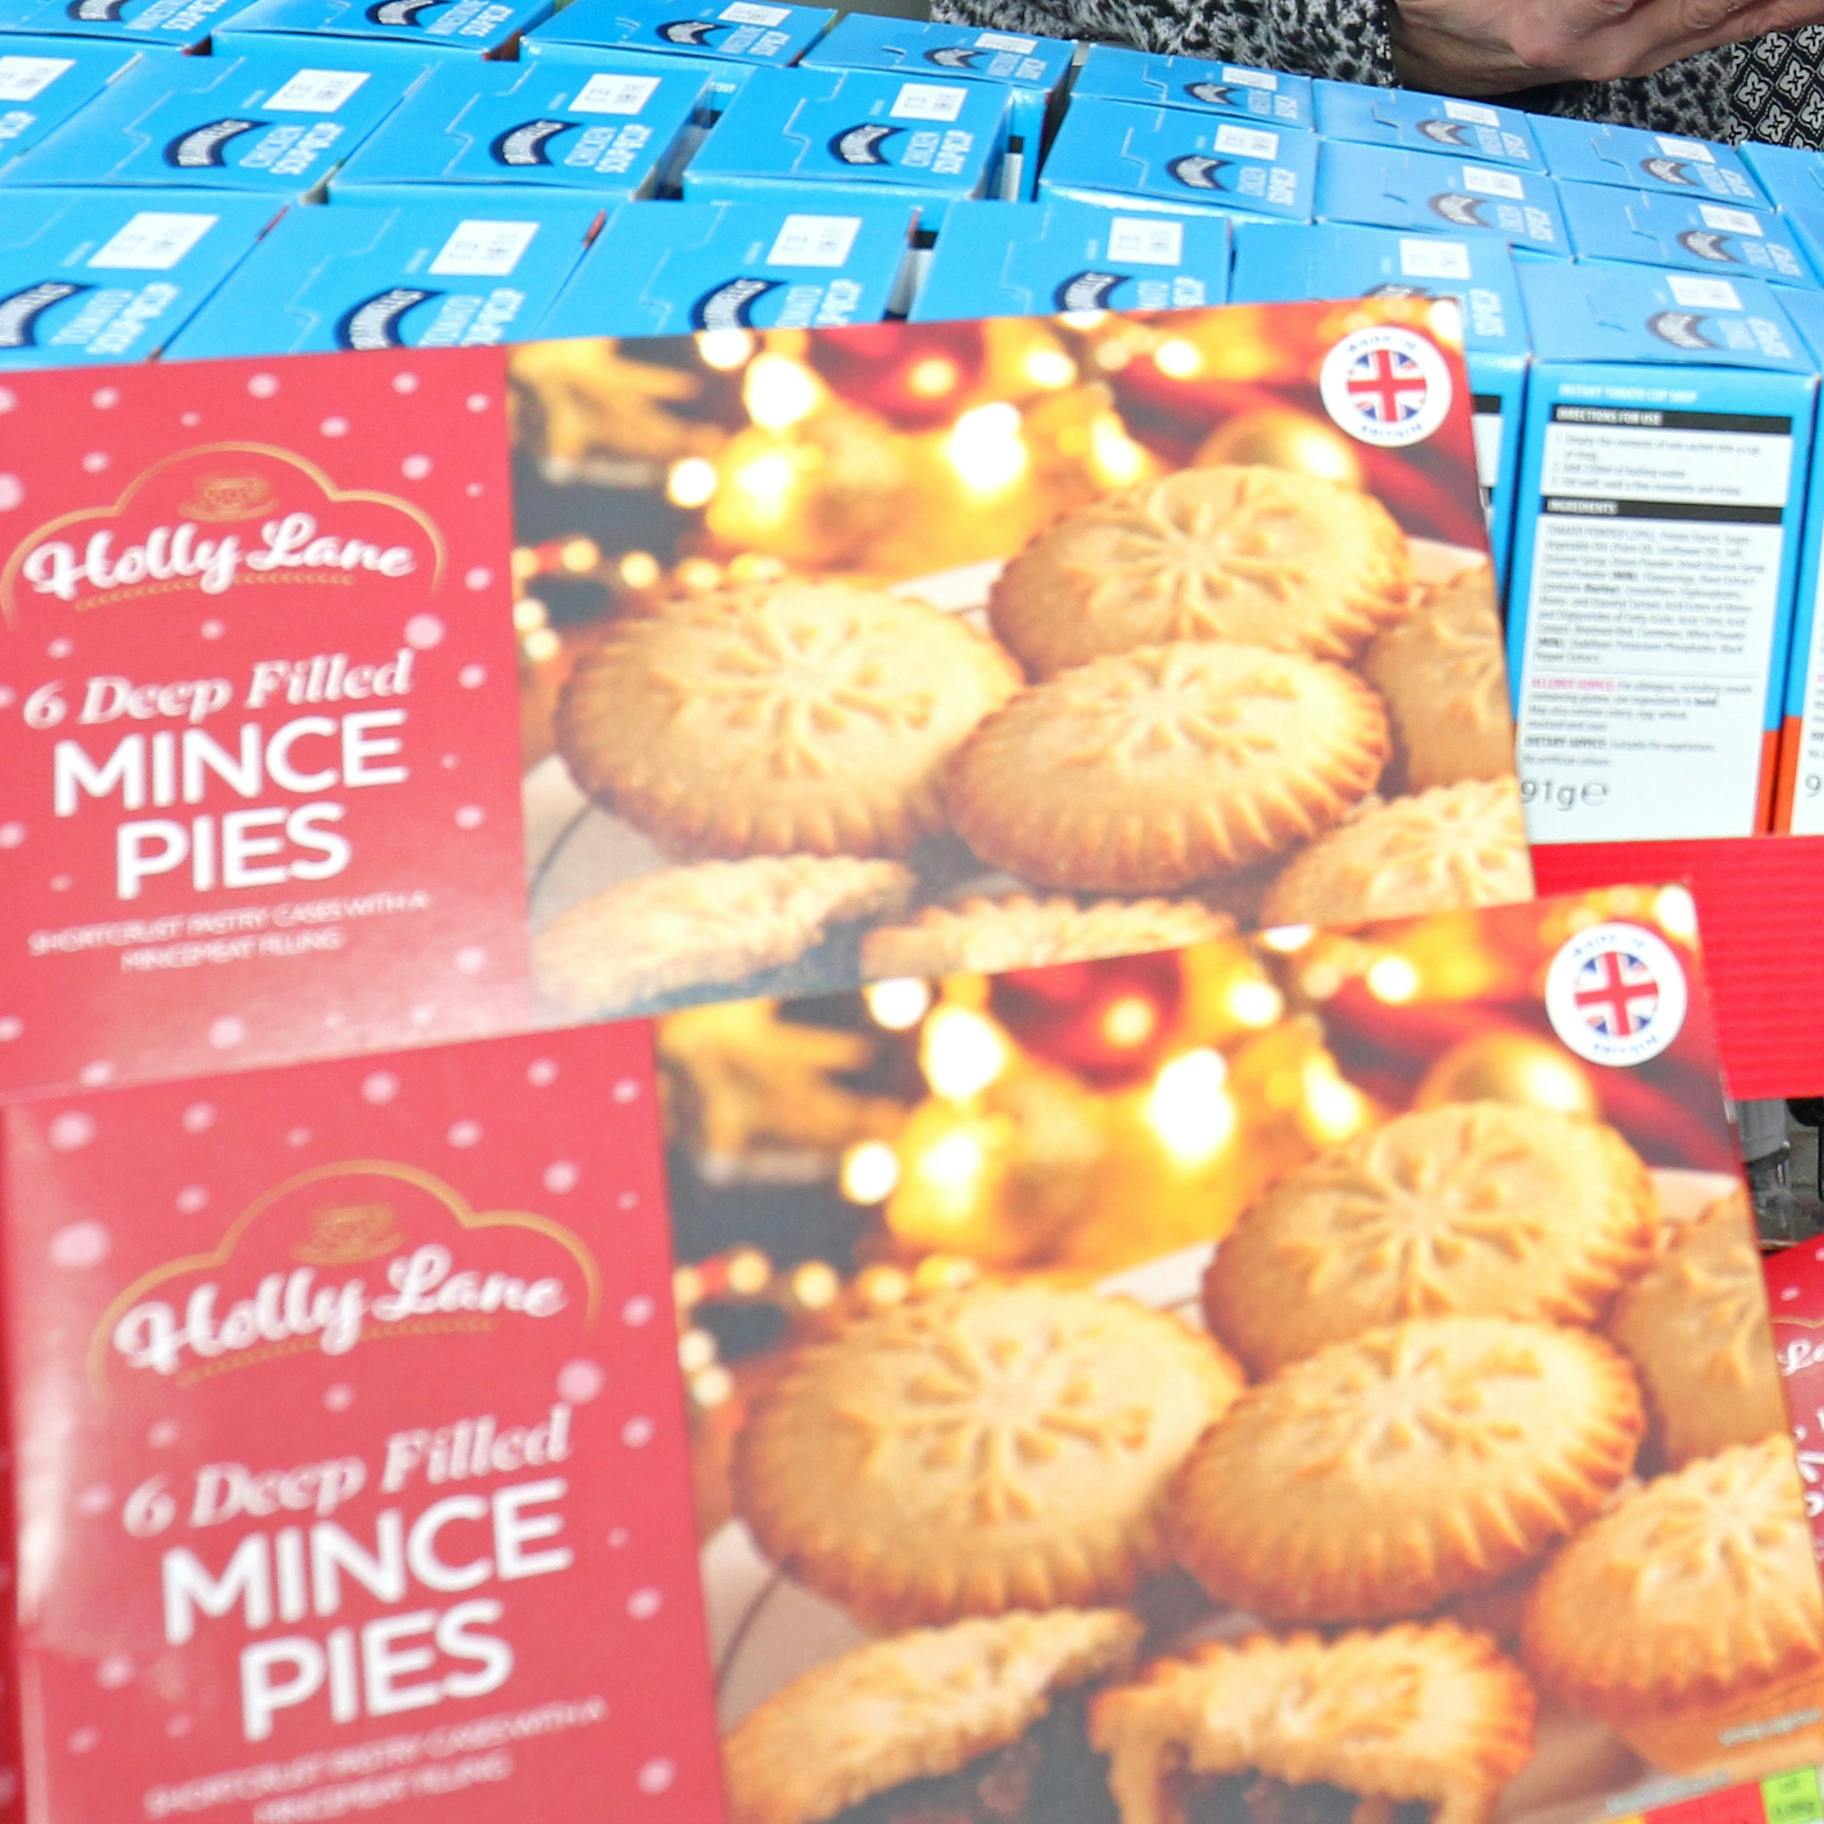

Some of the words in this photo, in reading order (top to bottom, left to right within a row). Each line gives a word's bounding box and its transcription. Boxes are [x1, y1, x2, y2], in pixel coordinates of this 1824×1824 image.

[24, 522, 243, 599] Holly
[253, 511, 417, 578] Lane
[23, 683, 68, 729] 6
[80, 671, 233, 728] Deep
[246, 647, 416, 709] Filled
[53, 709, 409, 819] MINCE
[115, 803, 352, 901] PIES
[113, 1268, 367, 1375] Holly
[373, 1243, 567, 1322] Lane
[123, 1476, 176, 1537] 6
[189, 1453, 367, 1530] Deep
[381, 1402, 574, 1495] Filled
[161, 1479, 574, 1646] MINCE
[239, 1598, 514, 1744] PIES
